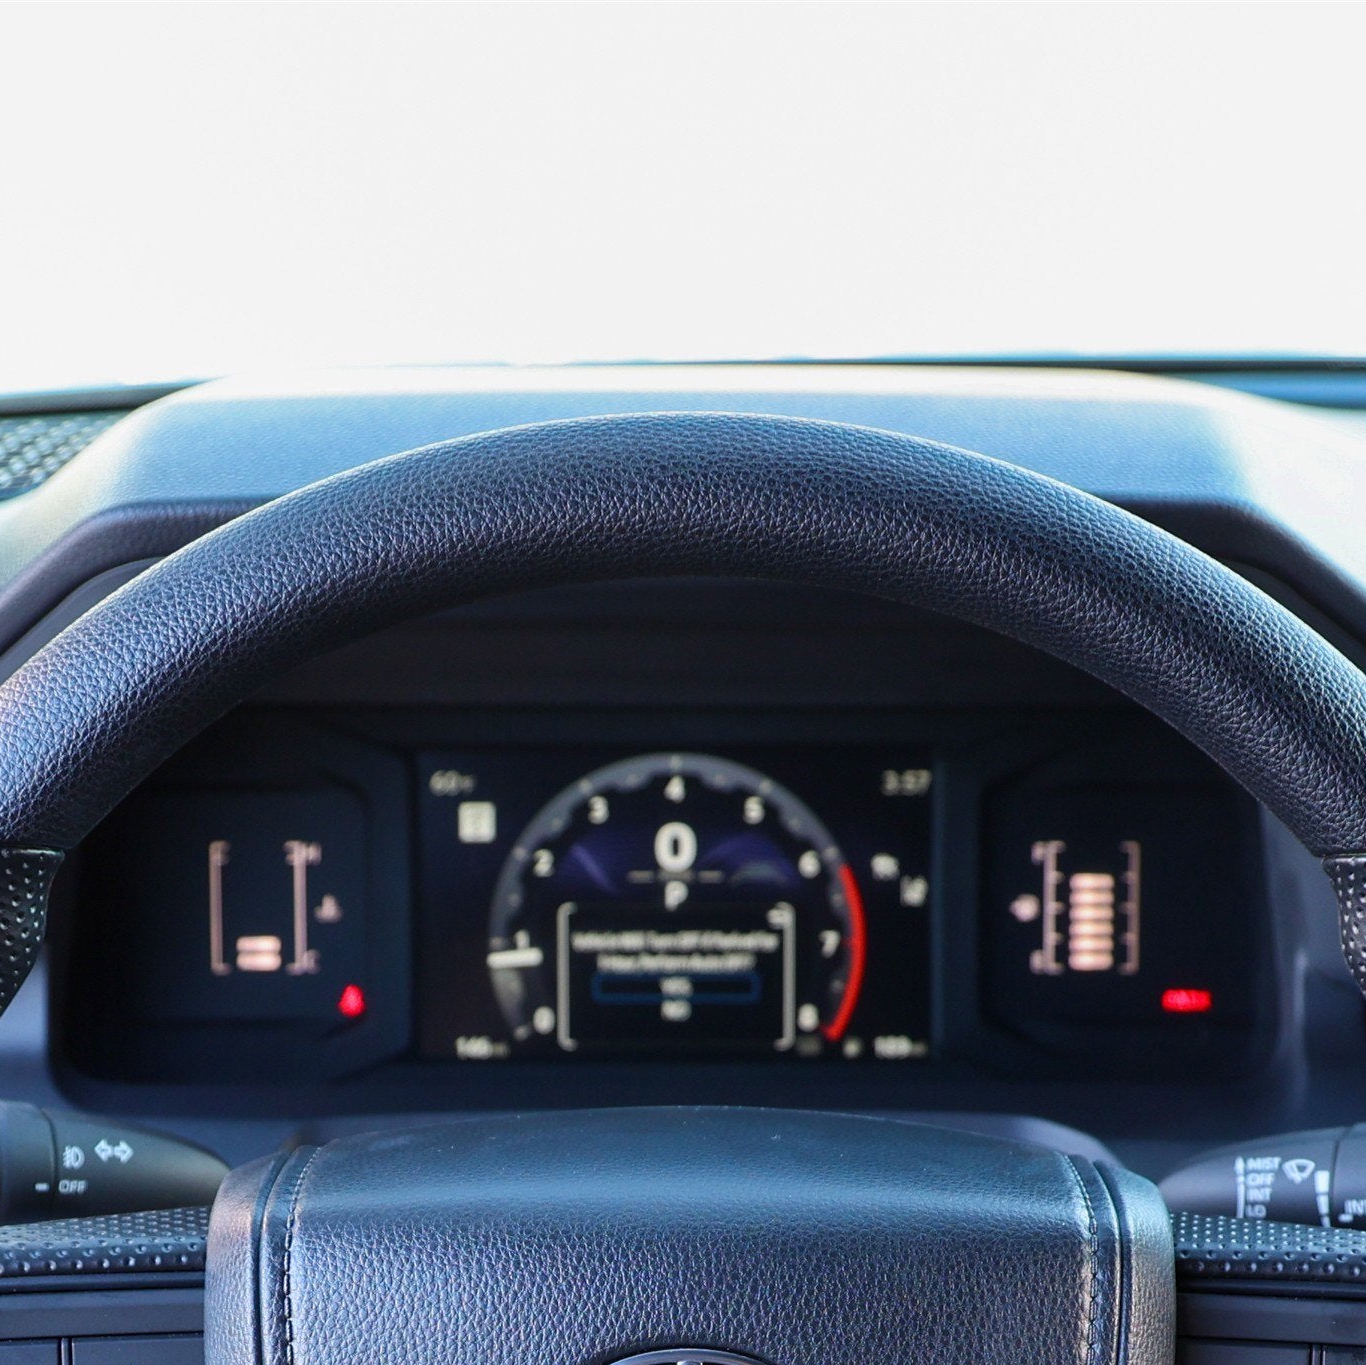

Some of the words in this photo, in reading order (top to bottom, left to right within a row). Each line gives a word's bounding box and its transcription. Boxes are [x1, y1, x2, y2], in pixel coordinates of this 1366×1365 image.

[664, 774, 685, 804] 4
[588, 795, 609, 825] 3
[744, 796, 765, 824] 5
[654, 821, 696, 873] 0
[534, 849, 554, 878] 2
[798, 850, 821, 879] 6
[665, 880, 688, 912] P
[819, 930, 841, 959] 7
[1246, 1157, 1281, 1170] MIST
[59, 1179, 86, 1194] OFF
[1246, 1173, 1275, 1185] OFF
[1248, 1188, 1273, 1202] INT
[1245, 1204, 1267, 1218] LO
